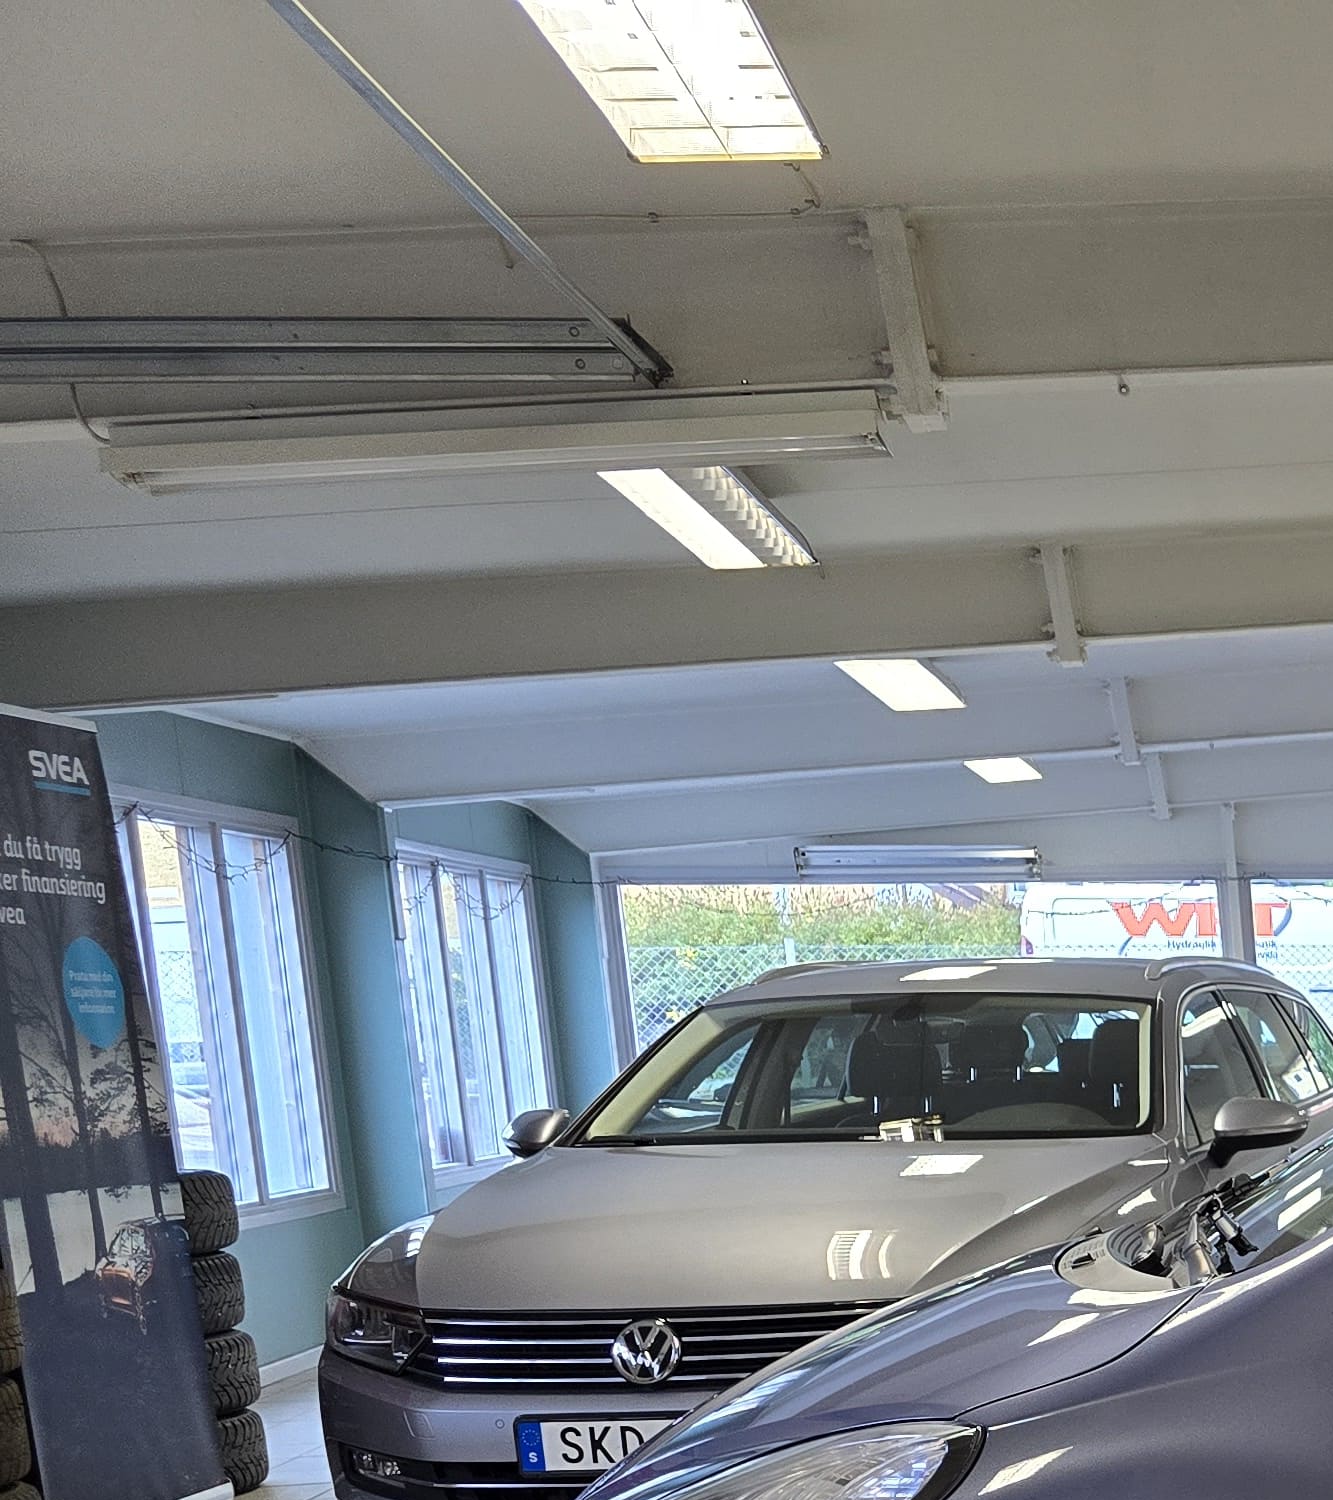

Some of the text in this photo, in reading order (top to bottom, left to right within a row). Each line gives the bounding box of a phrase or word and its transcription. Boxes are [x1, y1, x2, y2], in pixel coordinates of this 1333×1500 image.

[28, 749, 90, 786] SVEA
[3, 834, 82, 871] du få trygg
[21, 868, 106, 905] finansiering
[560, 1425, 646, 1464] SKD
